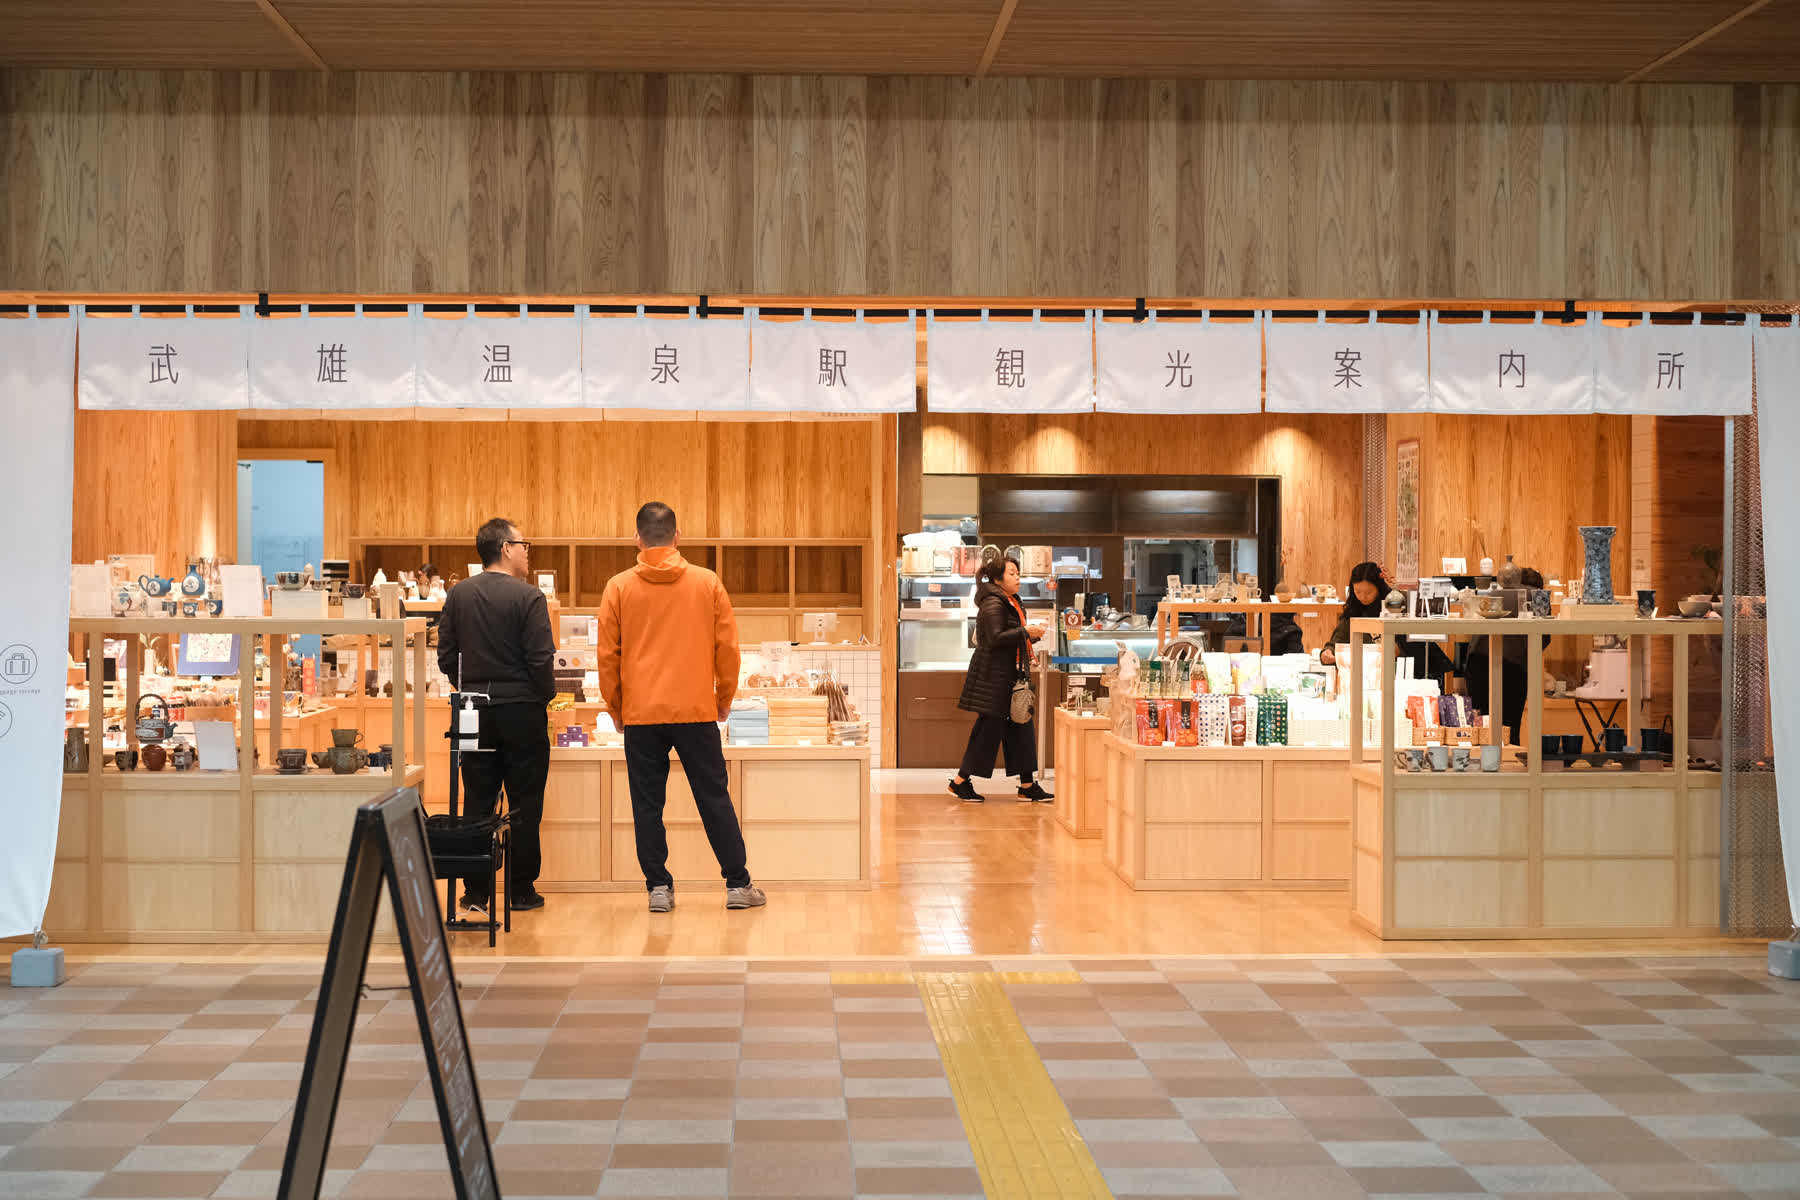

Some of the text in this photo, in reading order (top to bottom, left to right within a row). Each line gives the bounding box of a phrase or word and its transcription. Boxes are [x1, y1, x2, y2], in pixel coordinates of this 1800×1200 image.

[149, 344, 1685, 391] 武雄温泉駅観光案内所
